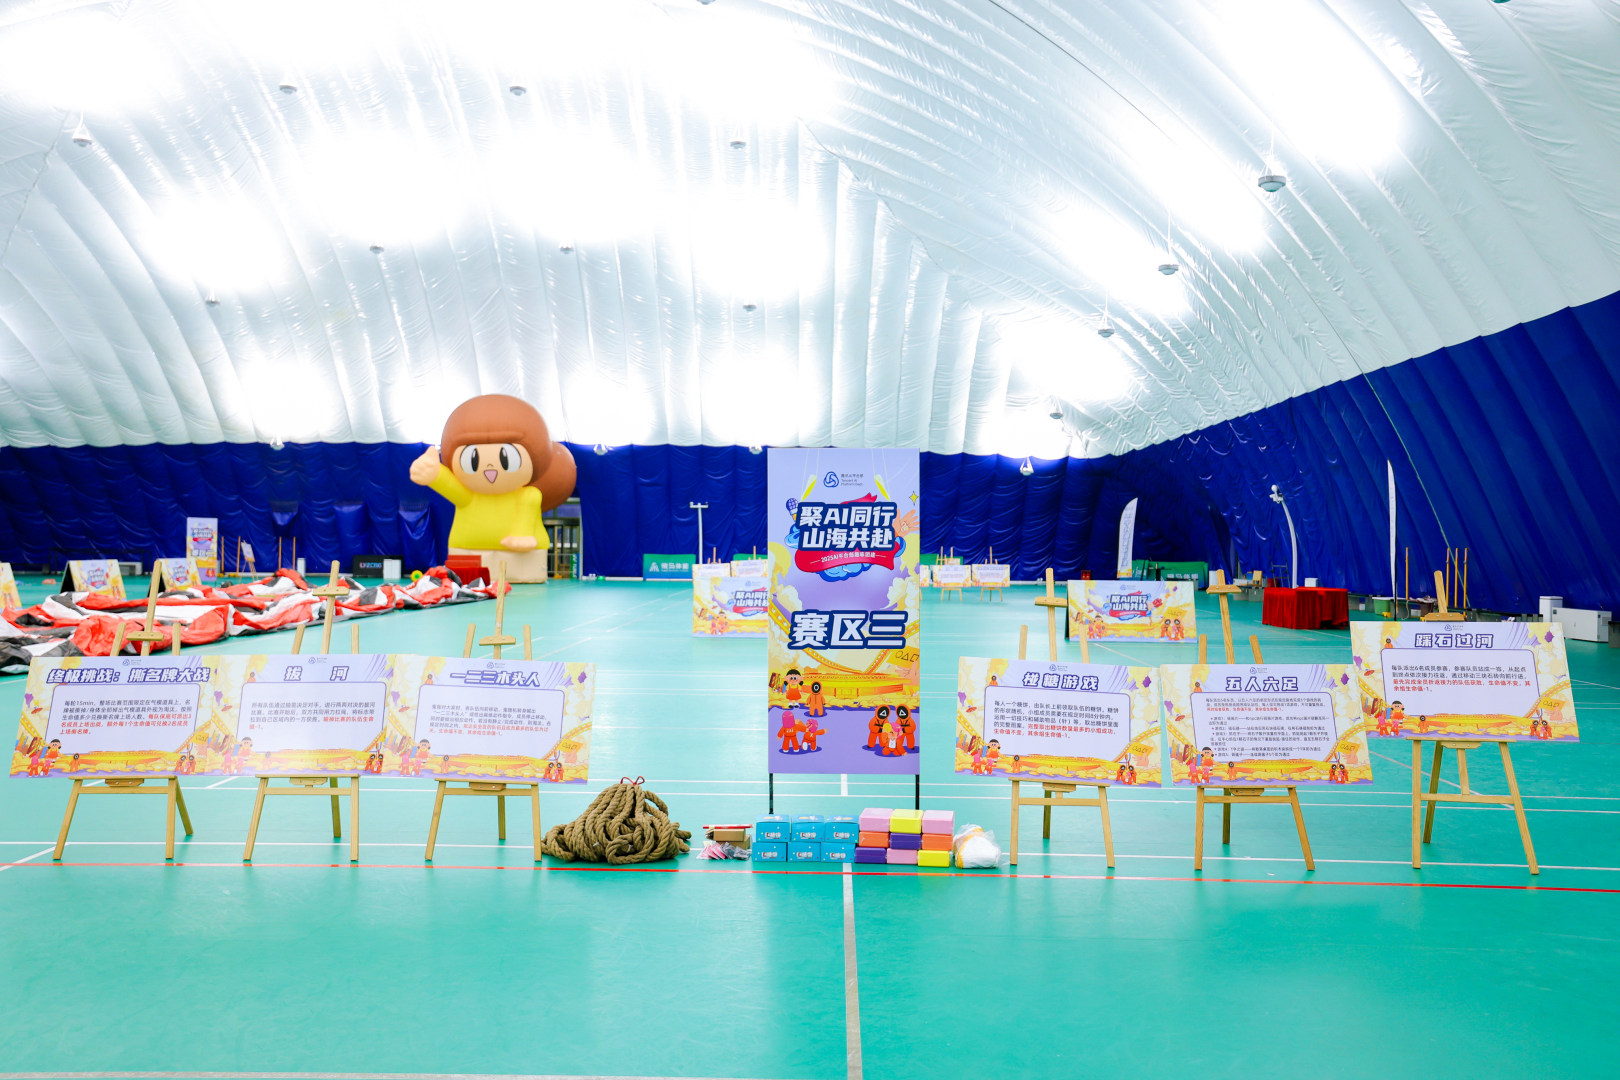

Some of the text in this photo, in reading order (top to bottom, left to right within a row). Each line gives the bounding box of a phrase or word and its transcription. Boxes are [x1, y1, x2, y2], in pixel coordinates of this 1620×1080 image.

[799, 506, 894, 527] 聚AI同行
[802, 528, 892, 548] 山海共赴
[1112, 603, 1148, 611] 山海共赴
[791, 612, 905, 647] 赛区三
[1415, 633, 1494, 648] 踩石过河
[46, 667, 210, 684] 终极挑战：撕名牌大战
[450, 670, 540, 687] 一二三木头人
[1022, 672, 1099, 691] 椪糖游戏
[1225, 676, 1298, 691] 五人六足
